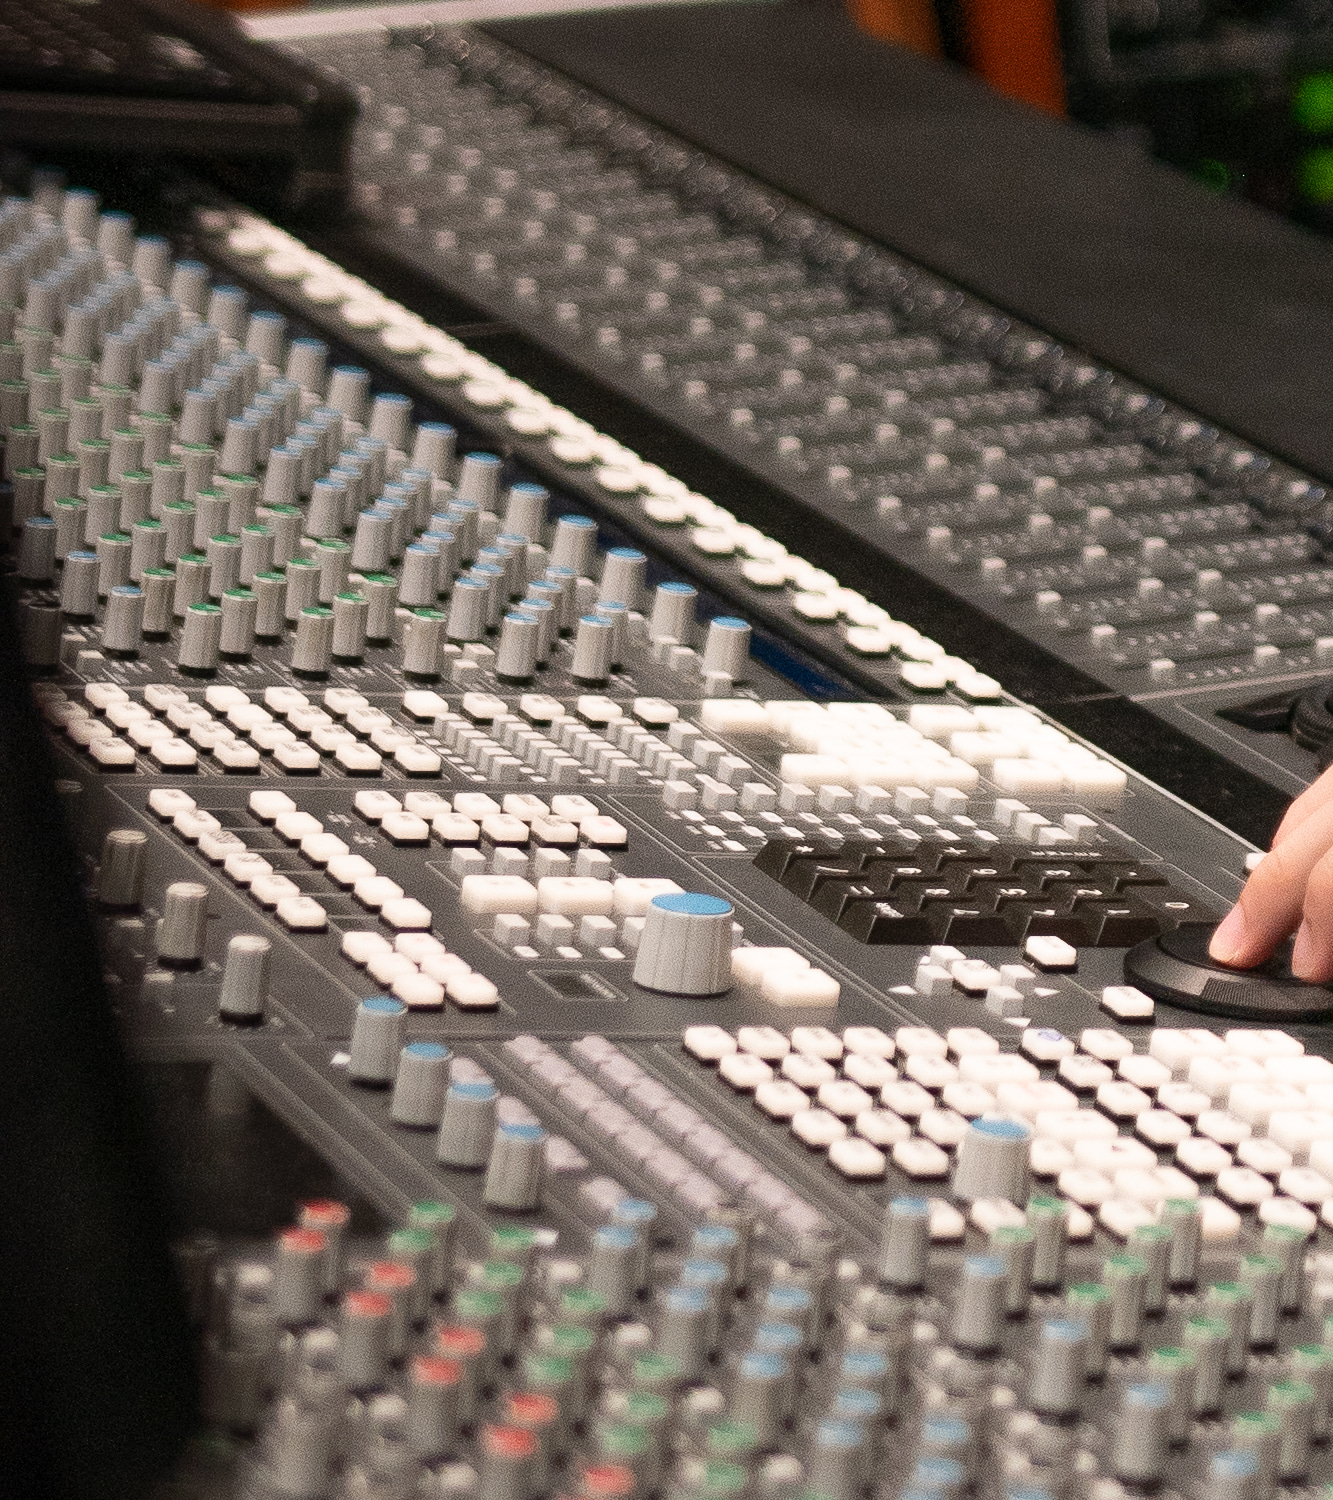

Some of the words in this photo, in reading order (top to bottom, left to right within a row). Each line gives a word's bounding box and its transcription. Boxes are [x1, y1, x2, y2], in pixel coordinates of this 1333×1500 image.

[896, 867, 922, 875] 9
[972, 868, 998, 876] 6
[1045, 869, 1071, 877] 3
[925, 888, 951, 896] 8
[999, 887, 1028, 896] 5
[1076, 888, 1103, 897] 2
[1164, 901, 1190, 910] 0
